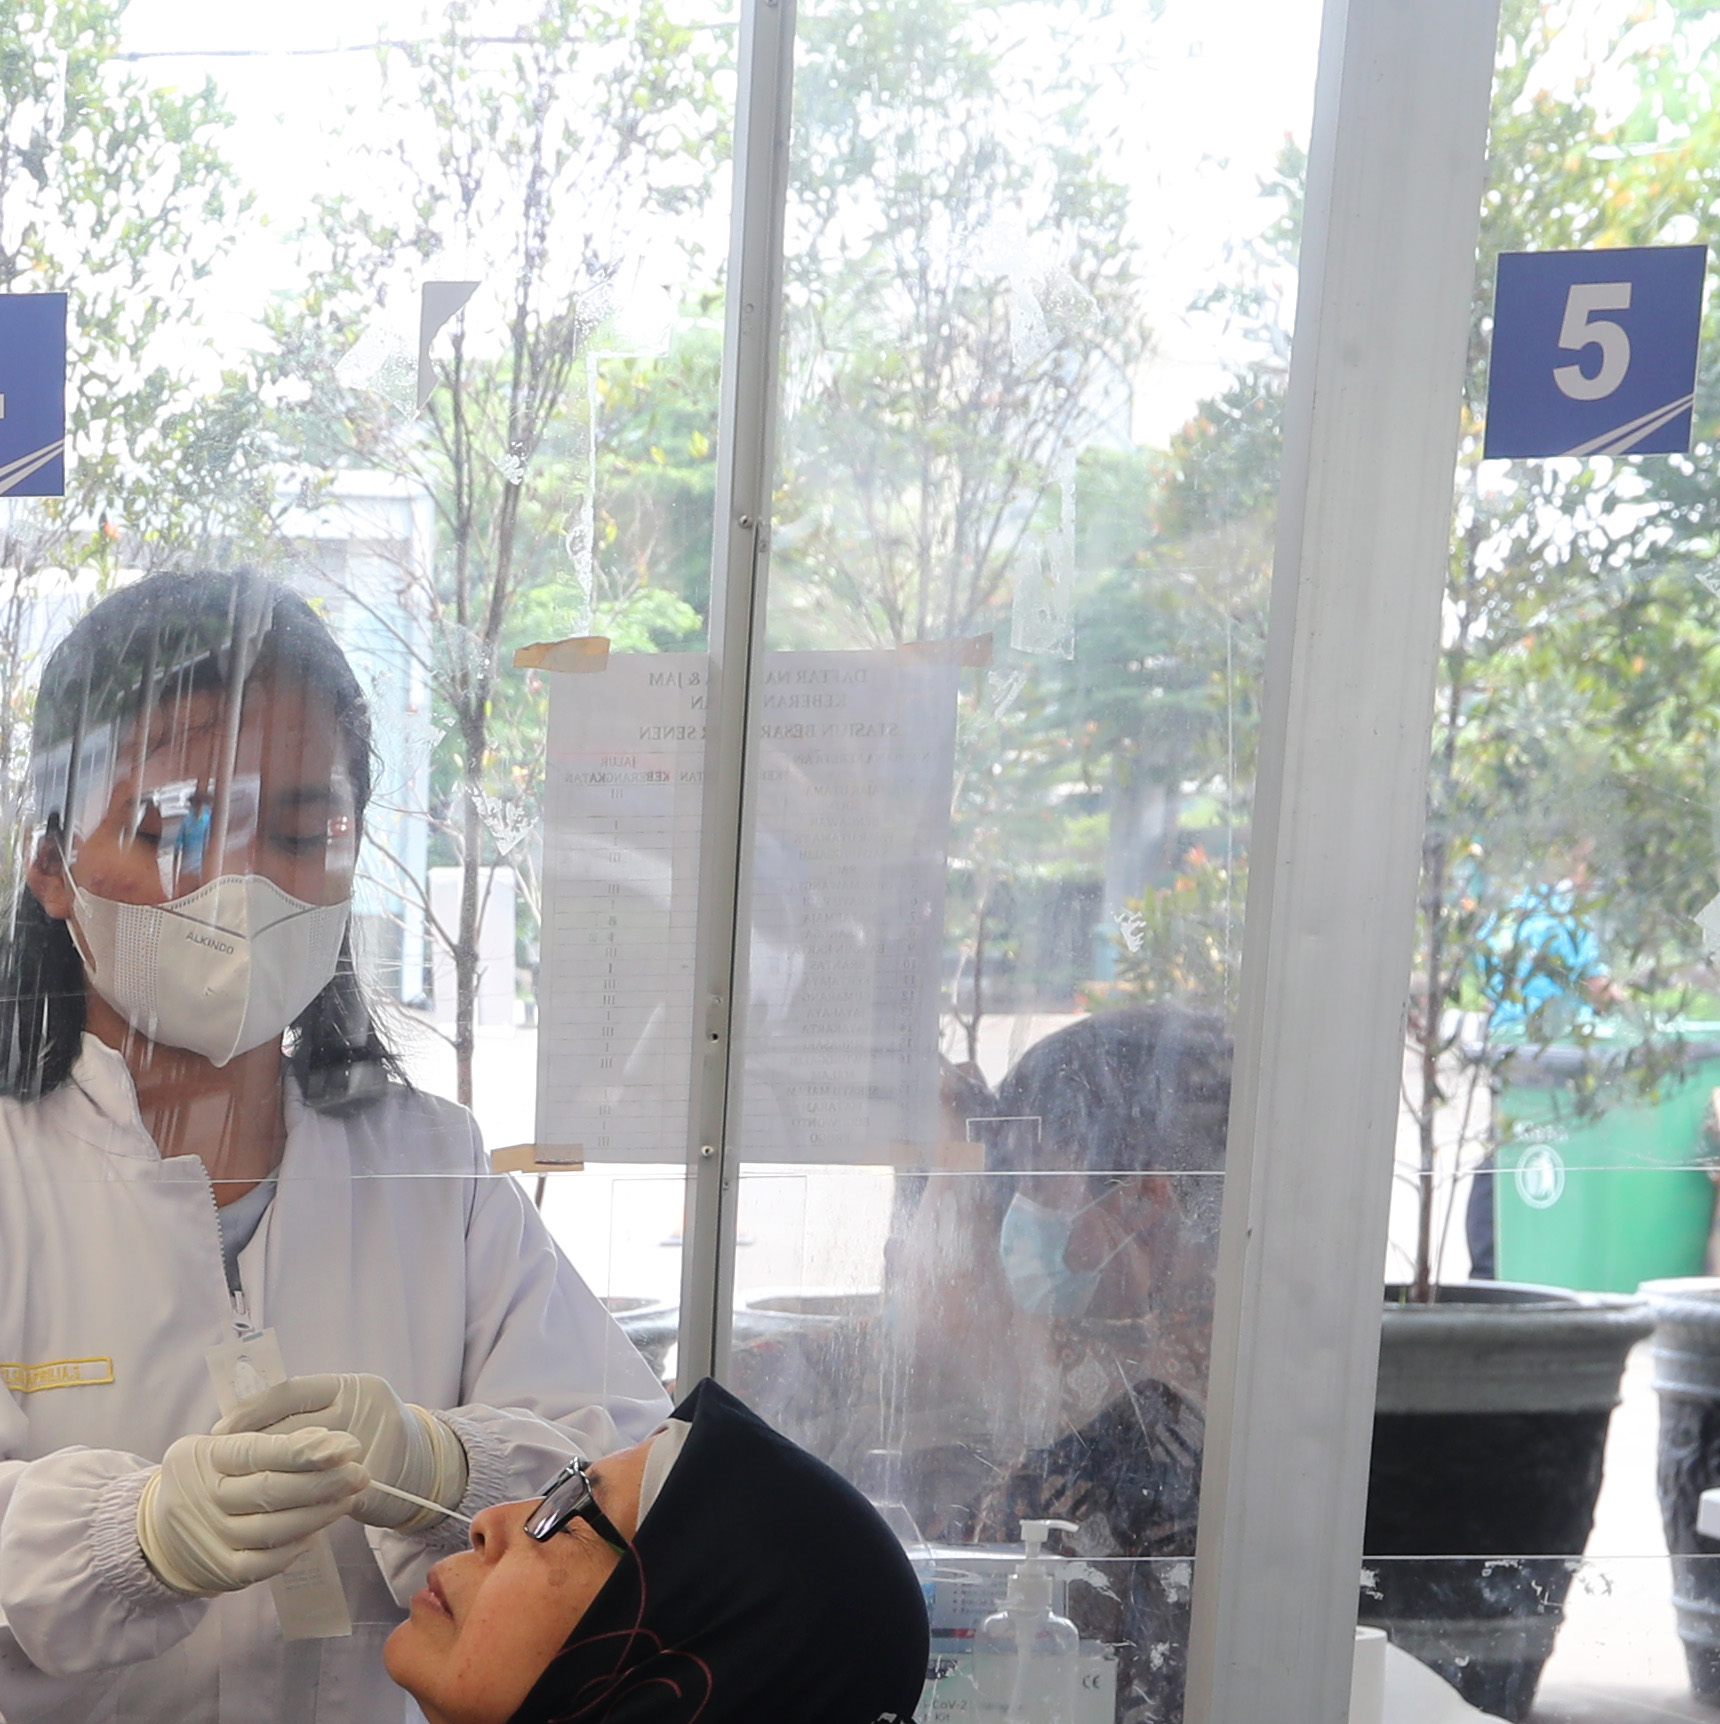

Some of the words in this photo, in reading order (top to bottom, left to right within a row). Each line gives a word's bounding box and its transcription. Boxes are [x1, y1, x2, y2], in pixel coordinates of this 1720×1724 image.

[1552, 282, 1632, 401] 5
[185, 931, 235, 956] ALKINDO
[935, 1713, 950, 1722] Kit
